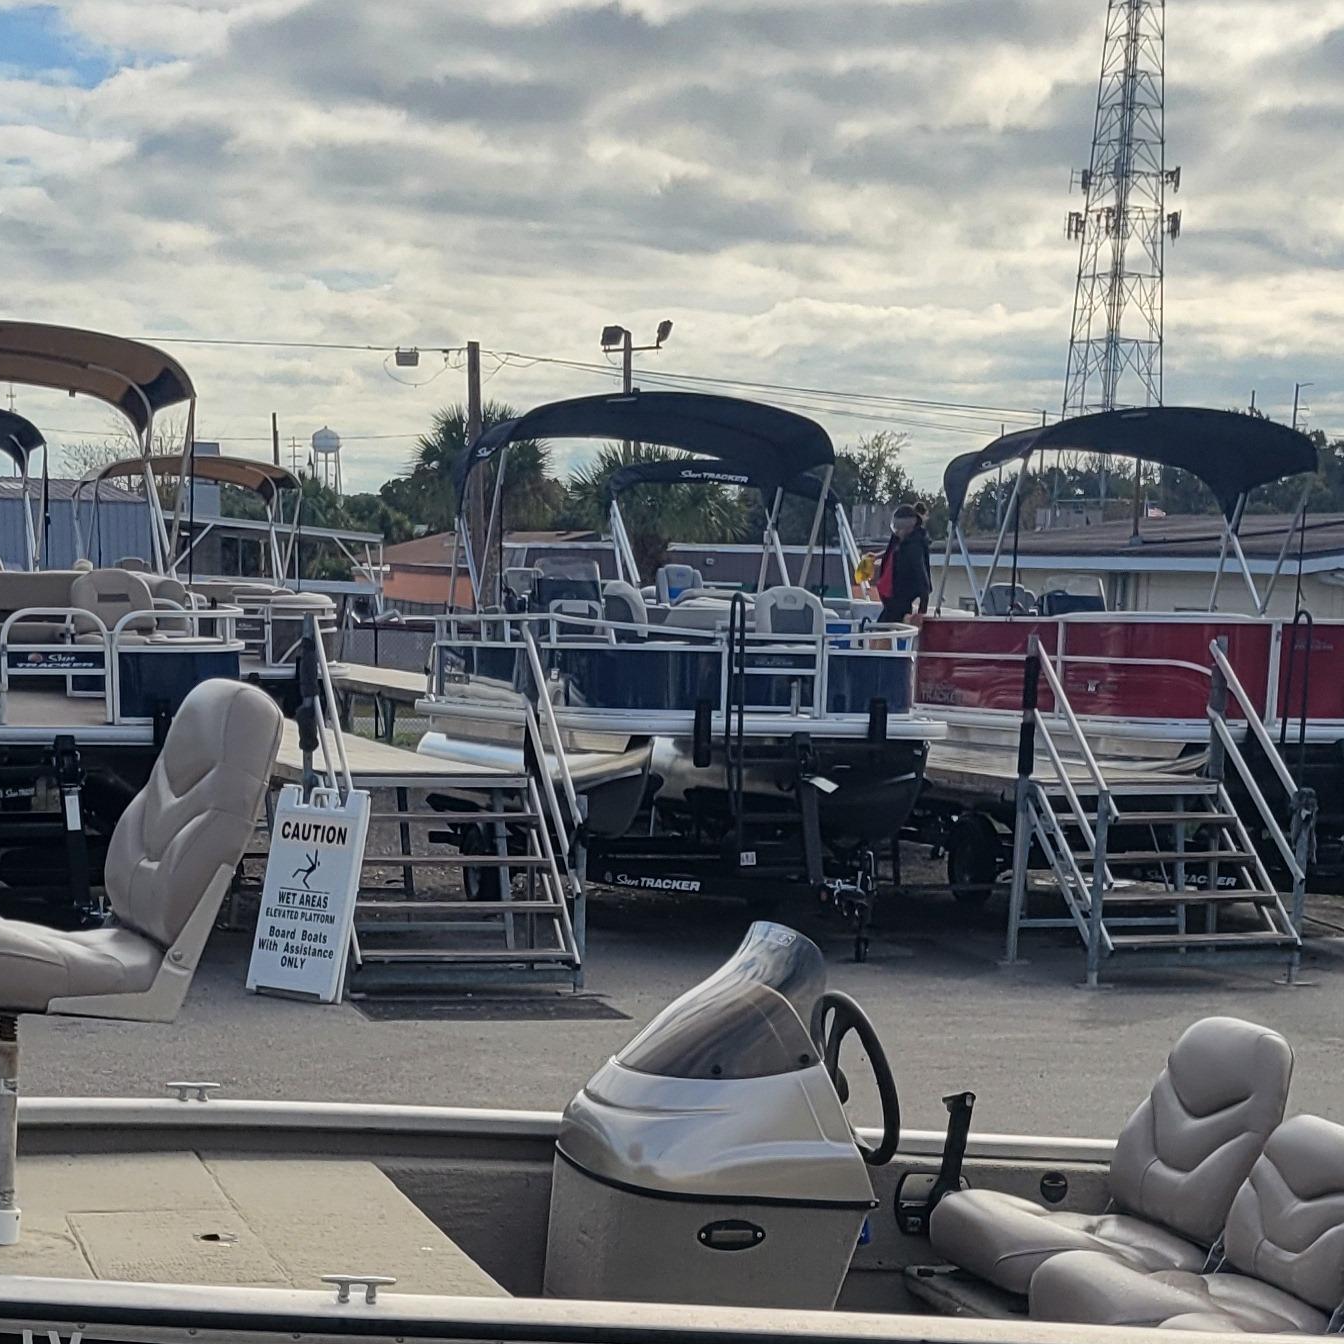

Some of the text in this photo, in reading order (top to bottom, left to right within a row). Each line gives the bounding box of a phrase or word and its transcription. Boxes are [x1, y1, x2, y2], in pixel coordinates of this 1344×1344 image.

[702, 472, 749, 483] TRACKER
[281, 821, 347, 845] CAUTION
[616, 873, 700, 892] Sun TRACKER
[278, 890, 329, 909] WET AREAS
[265, 907, 336, 925] ELEVATED PLATFORM
[268, 925, 328, 944] Board Boats
[258, 938, 334, 959] With Assistance
[280, 955, 307, 970] ONLY
